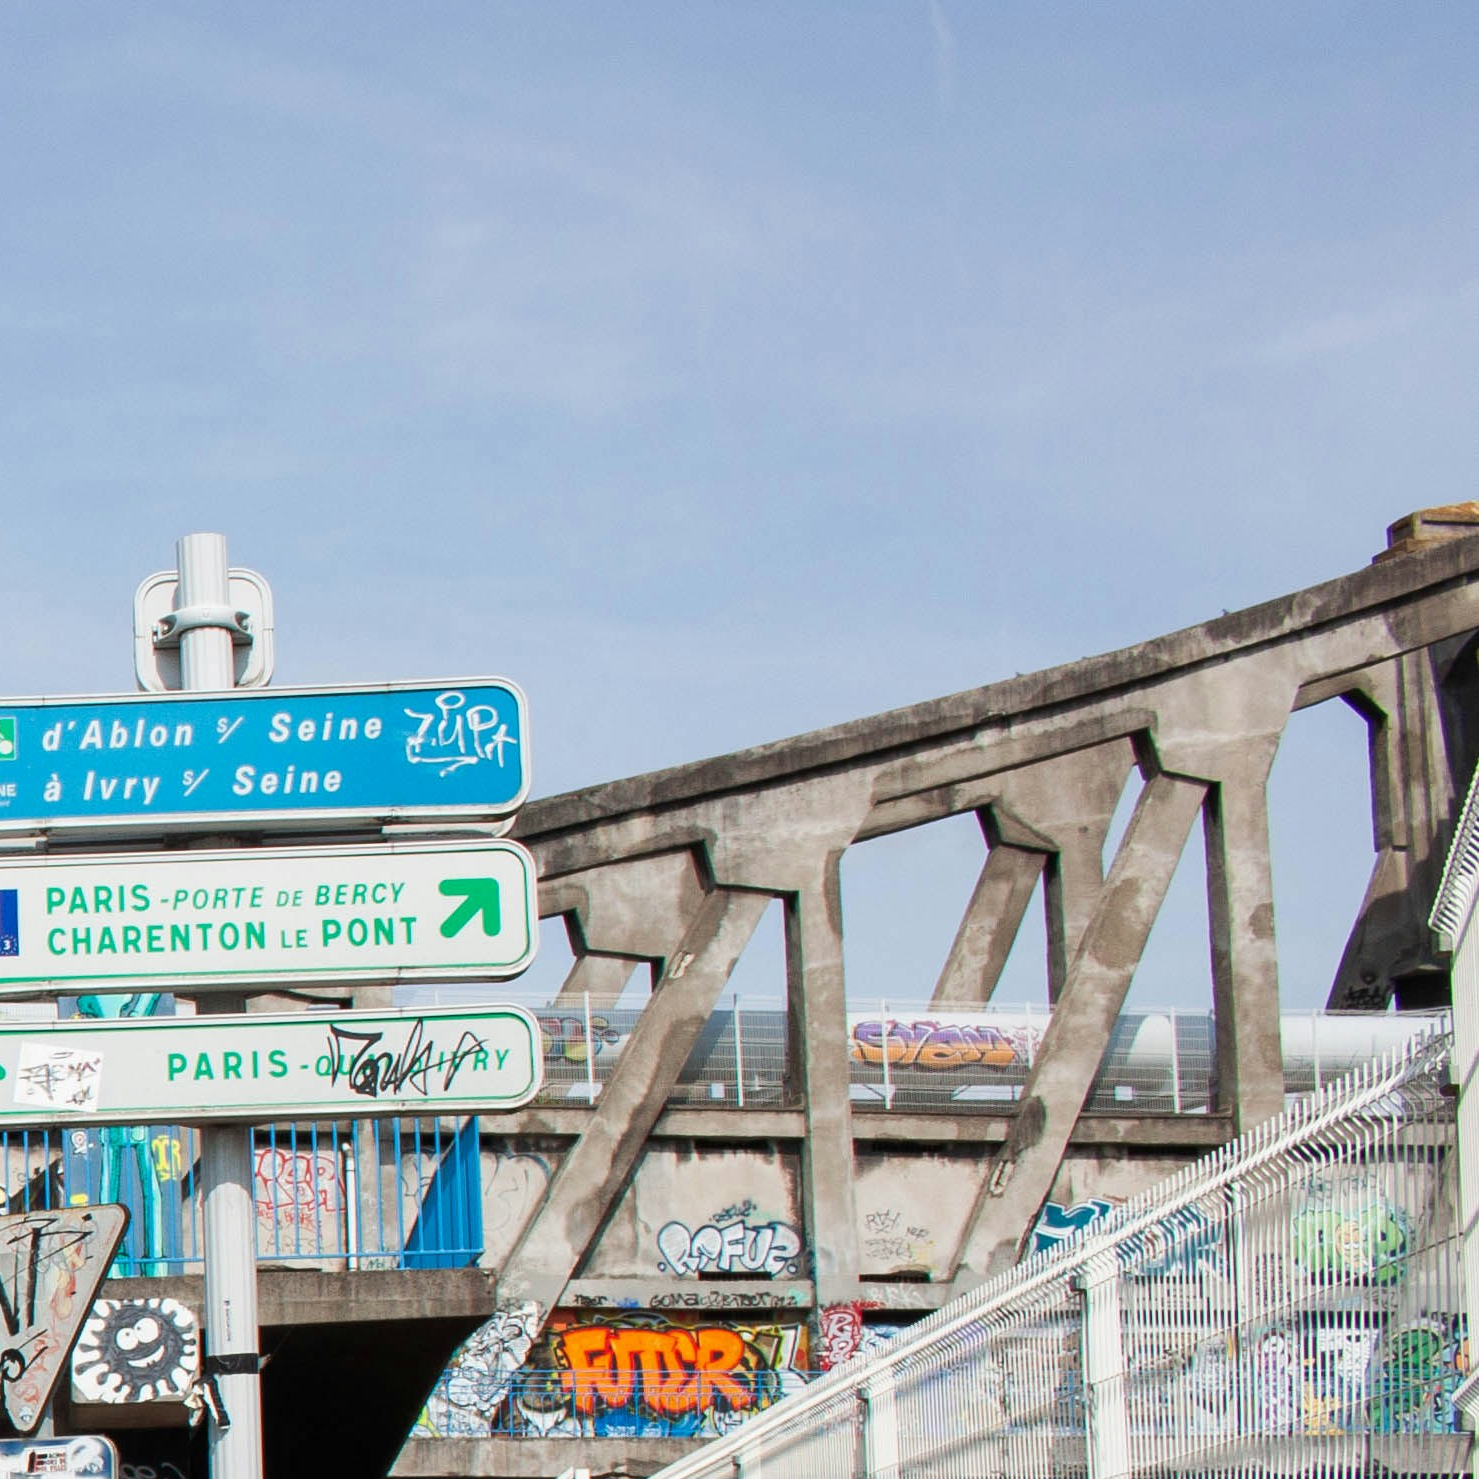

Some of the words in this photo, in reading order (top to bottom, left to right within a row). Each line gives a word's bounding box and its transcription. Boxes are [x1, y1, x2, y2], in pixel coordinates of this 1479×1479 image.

[42, 717, 194, 752] d'Ablon
[268, 712, 383, 744] Seine
[43, 773, 63, 803] à
[82, 769, 161, 805] Ivry
[232, 765, 343, 796] Seine
[46, 884, 151, 915] PARIS
[275, 890, 304, 908] DE
[314, 882, 405, 906] BERCY
[2, 939, 12, 951] 3
[47, 920, 267, 956] CHARENTON
[280, 929, 308, 949] LE
[321, 916, 418, 948] PONT
[167, 1050, 289, 1082] PARIS
